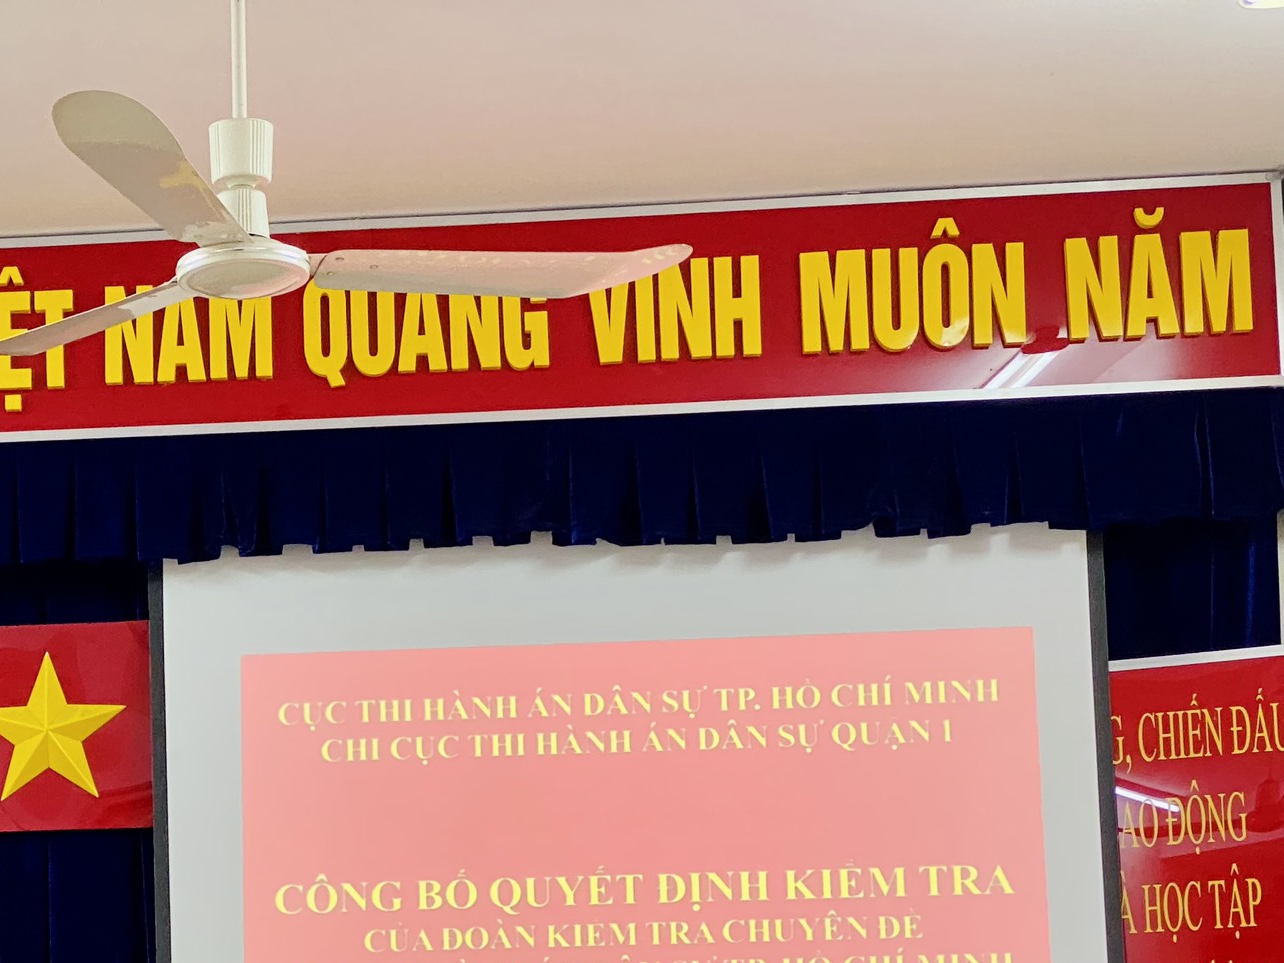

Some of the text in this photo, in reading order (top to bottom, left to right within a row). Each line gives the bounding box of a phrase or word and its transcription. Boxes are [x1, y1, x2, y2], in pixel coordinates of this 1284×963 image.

[104, 285, 273, 386] NAM
[303, 278, 550, 387] QUANG
[799, 217, 1027, 355] MUÔN
[1064, 206, 1254, 341] NĂM
[277, 701, 347, 732] CỤC
[355, 699, 413, 723] THI
[423, 689, 518, 721] HÀNH
[527, 687, 572, 718] ÁN
[583, 684, 651, 716] DÂN
[661, 684, 708, 719] SỰ
[713, 686, 761, 712] TP.
[830, 674, 893, 707] CHÍ
[903, 678, 1000, 705] MINH
[1138, 693, 1224, 763] CHIẾN
[321, 737, 380, 762] CHI
[390, 735, 460, 765] CỤC
[468, 732, 525, 758] THI
[536, 724, 632, 755] HÀNH
[642, 721, 687, 753] ÁN
[698, 719, 768, 751] DÂN
[778, 719, 825, 753] SỰ
[942, 719, 953, 743] 1
[1165, 780, 1248, 855] ĐỘNG
[274, 873, 403, 915] CÔNG
[417, 869, 478, 911] BỐ
[489, 865, 644, 915] QUYẾT
[657, 870, 769, 912] ĐỊNH
[919, 864, 1016, 897] TRA
[1142, 880, 1203, 943] HỌC
[1208, 863, 1263, 939] TẬP
[364, 921, 434, 953] CỦA
[441, 918, 536, 951] ĐOÀN
[645, 921, 716, 946] TRA
[722, 909, 867, 943] CHUYÊN
